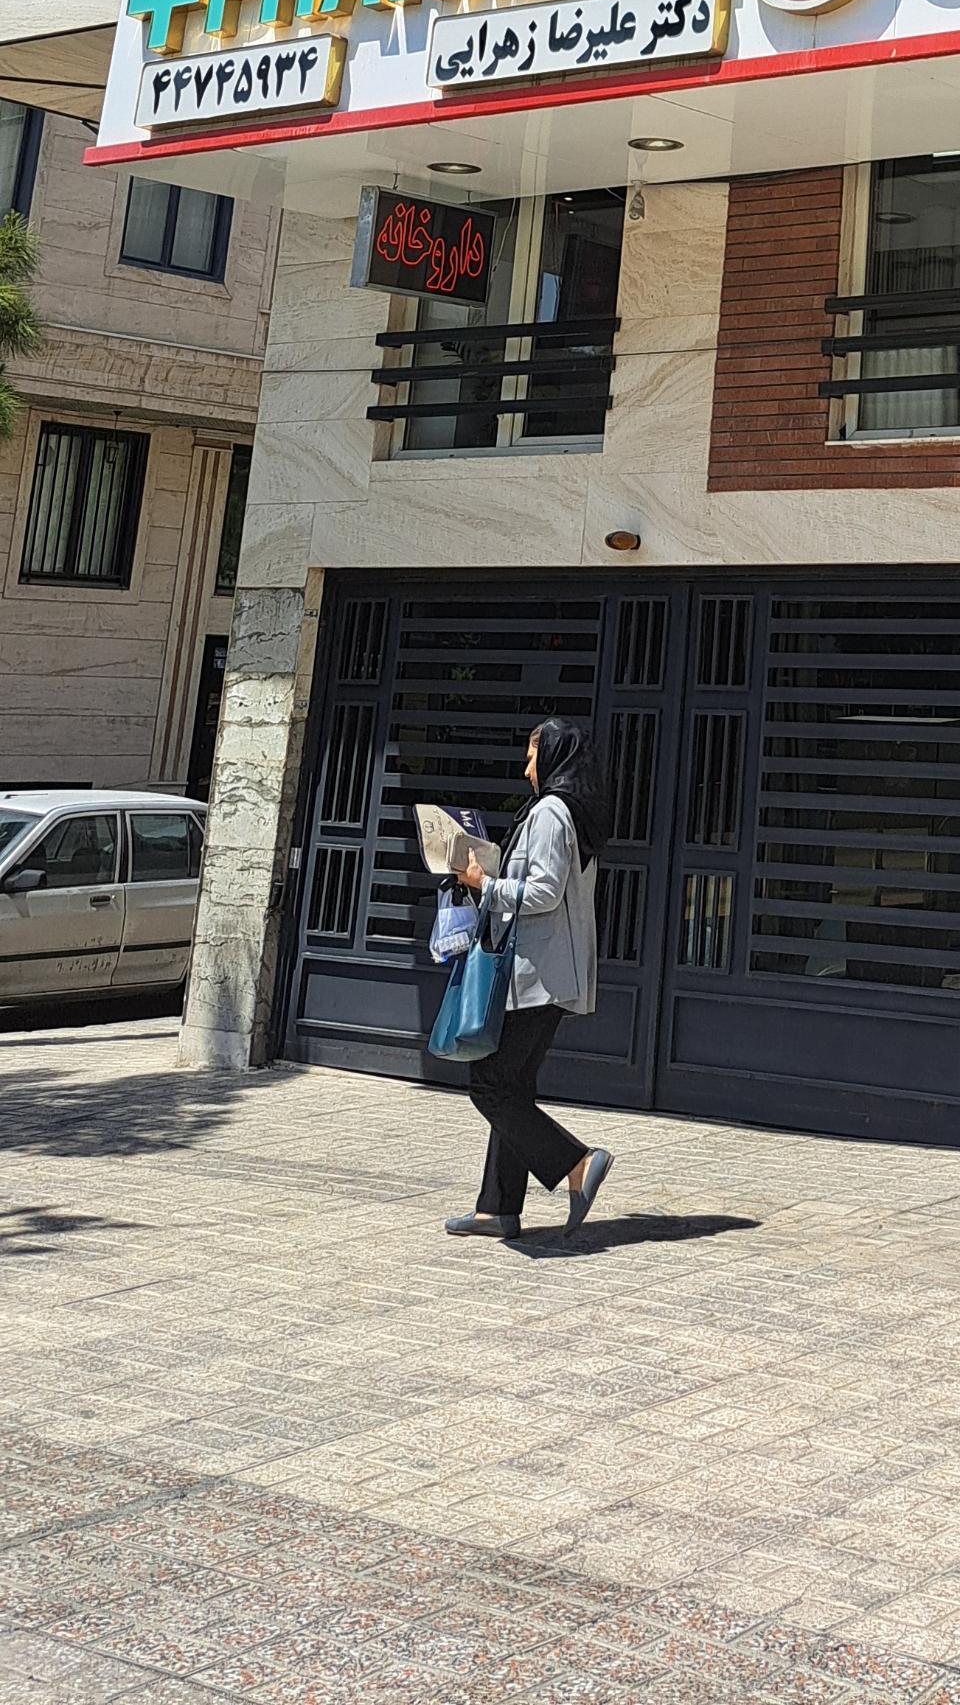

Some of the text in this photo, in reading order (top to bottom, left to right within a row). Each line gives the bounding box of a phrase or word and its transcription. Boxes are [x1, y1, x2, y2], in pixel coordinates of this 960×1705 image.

[434, 20, 535, 82] زهرایی
[547, 3, 636, 62] علیرضا
[152, 45, 318, 115] ۴۴۷۴۵۹۳۴
[376, 202, 484, 292] داروخانه
